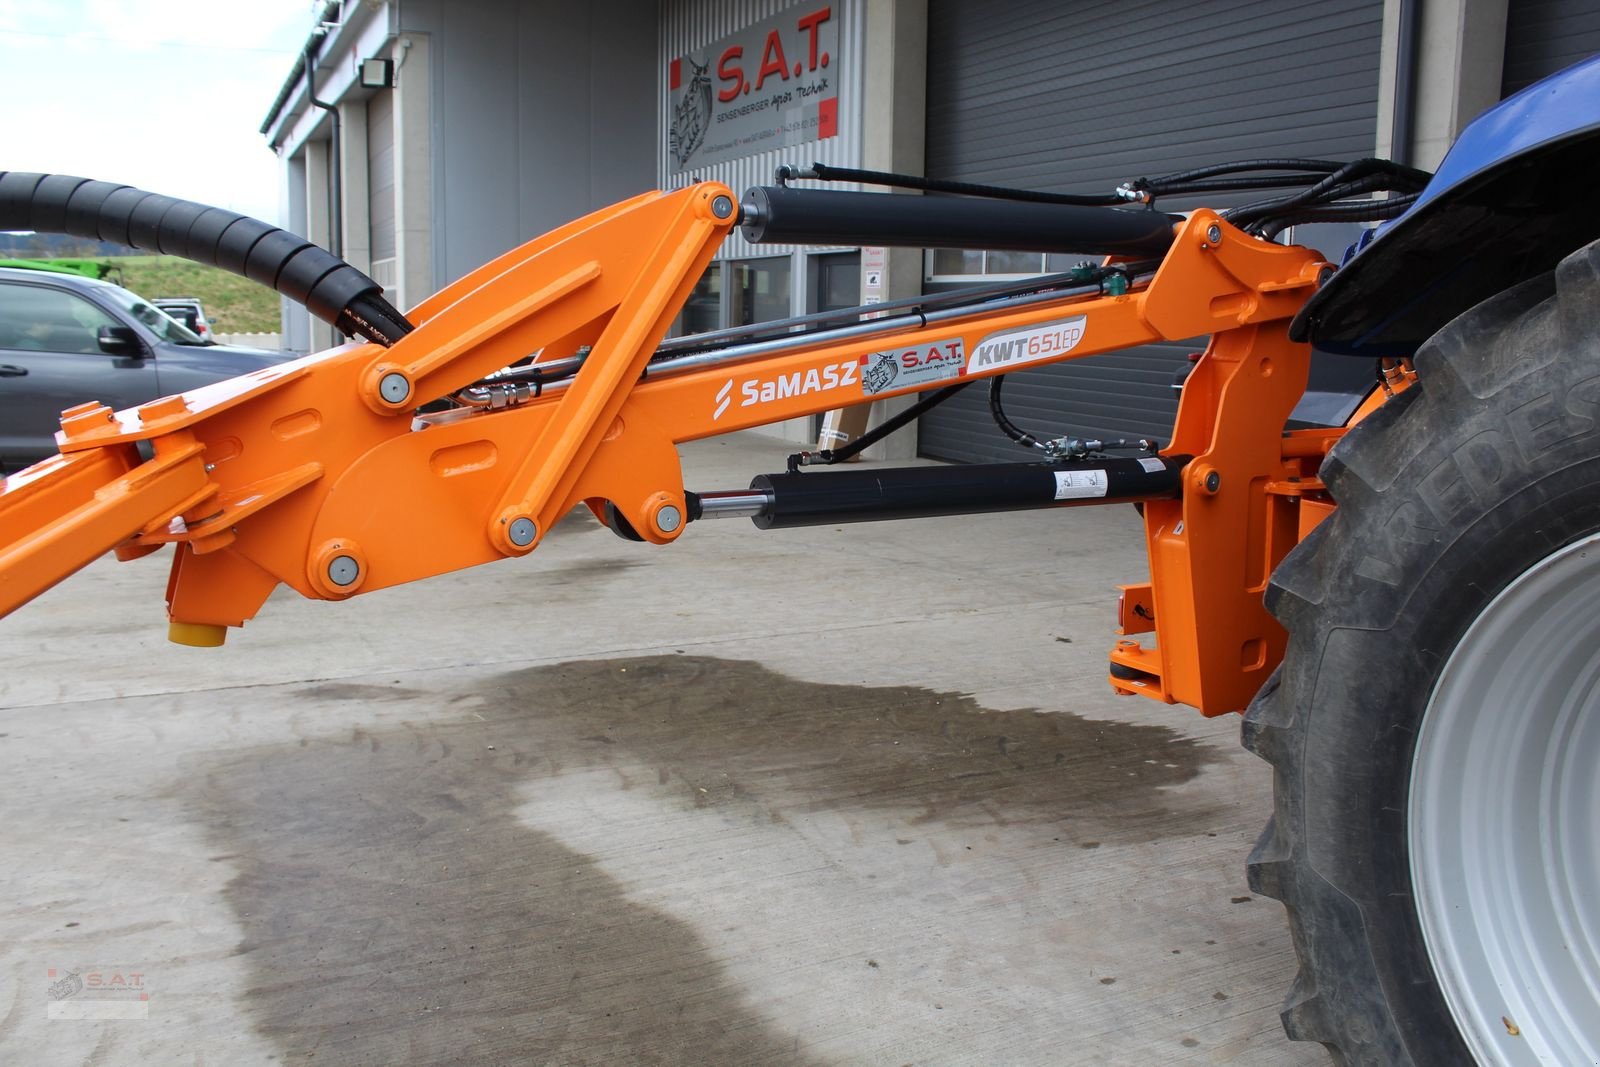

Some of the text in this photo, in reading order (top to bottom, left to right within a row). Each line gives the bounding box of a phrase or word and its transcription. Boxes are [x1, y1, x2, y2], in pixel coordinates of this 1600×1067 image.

[717, 7, 831, 103] S.A.T.
[901, 342, 961, 368] S.A.T.
[978, 328, 1080, 367] KWT651EP
[741, 360, 858, 407] SaMASZ
